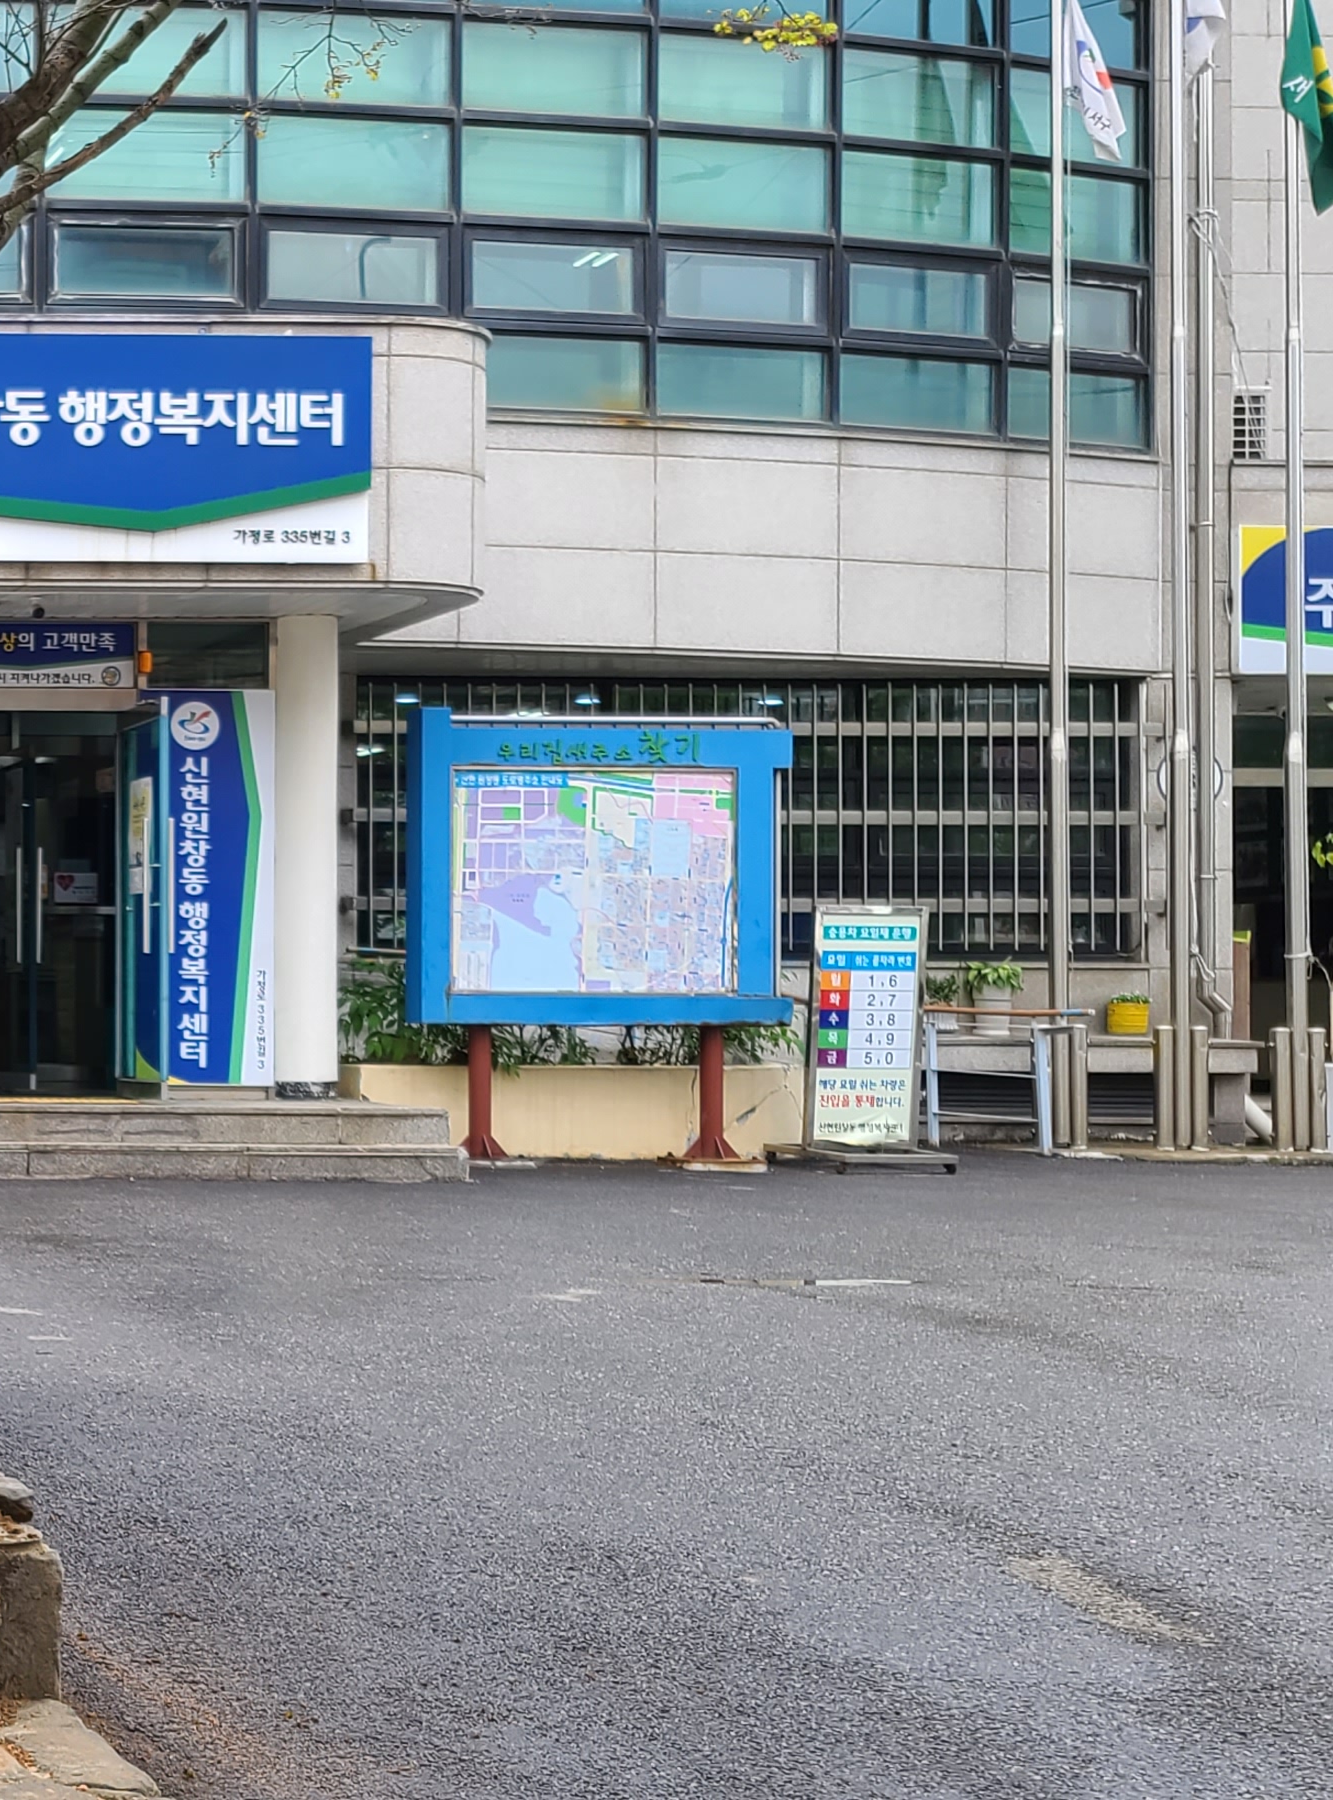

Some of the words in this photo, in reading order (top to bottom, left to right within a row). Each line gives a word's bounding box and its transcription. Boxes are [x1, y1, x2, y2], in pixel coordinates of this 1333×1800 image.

[59, 388, 345, 448] 행정복지센터
[233, 528, 276, 545] 가정로
[280, 528, 337, 545] 335번길
[341, 530, 351, 544] 3
[42, 632, 117, 652] 고객만족
[9, 672, 96, 685] 지켜나가겠습니다.
[178, 756, 210, 896] 신현원창동
[827, 953, 846, 967] 요일
[177, 901, 210, 1068] 행정복지센터
